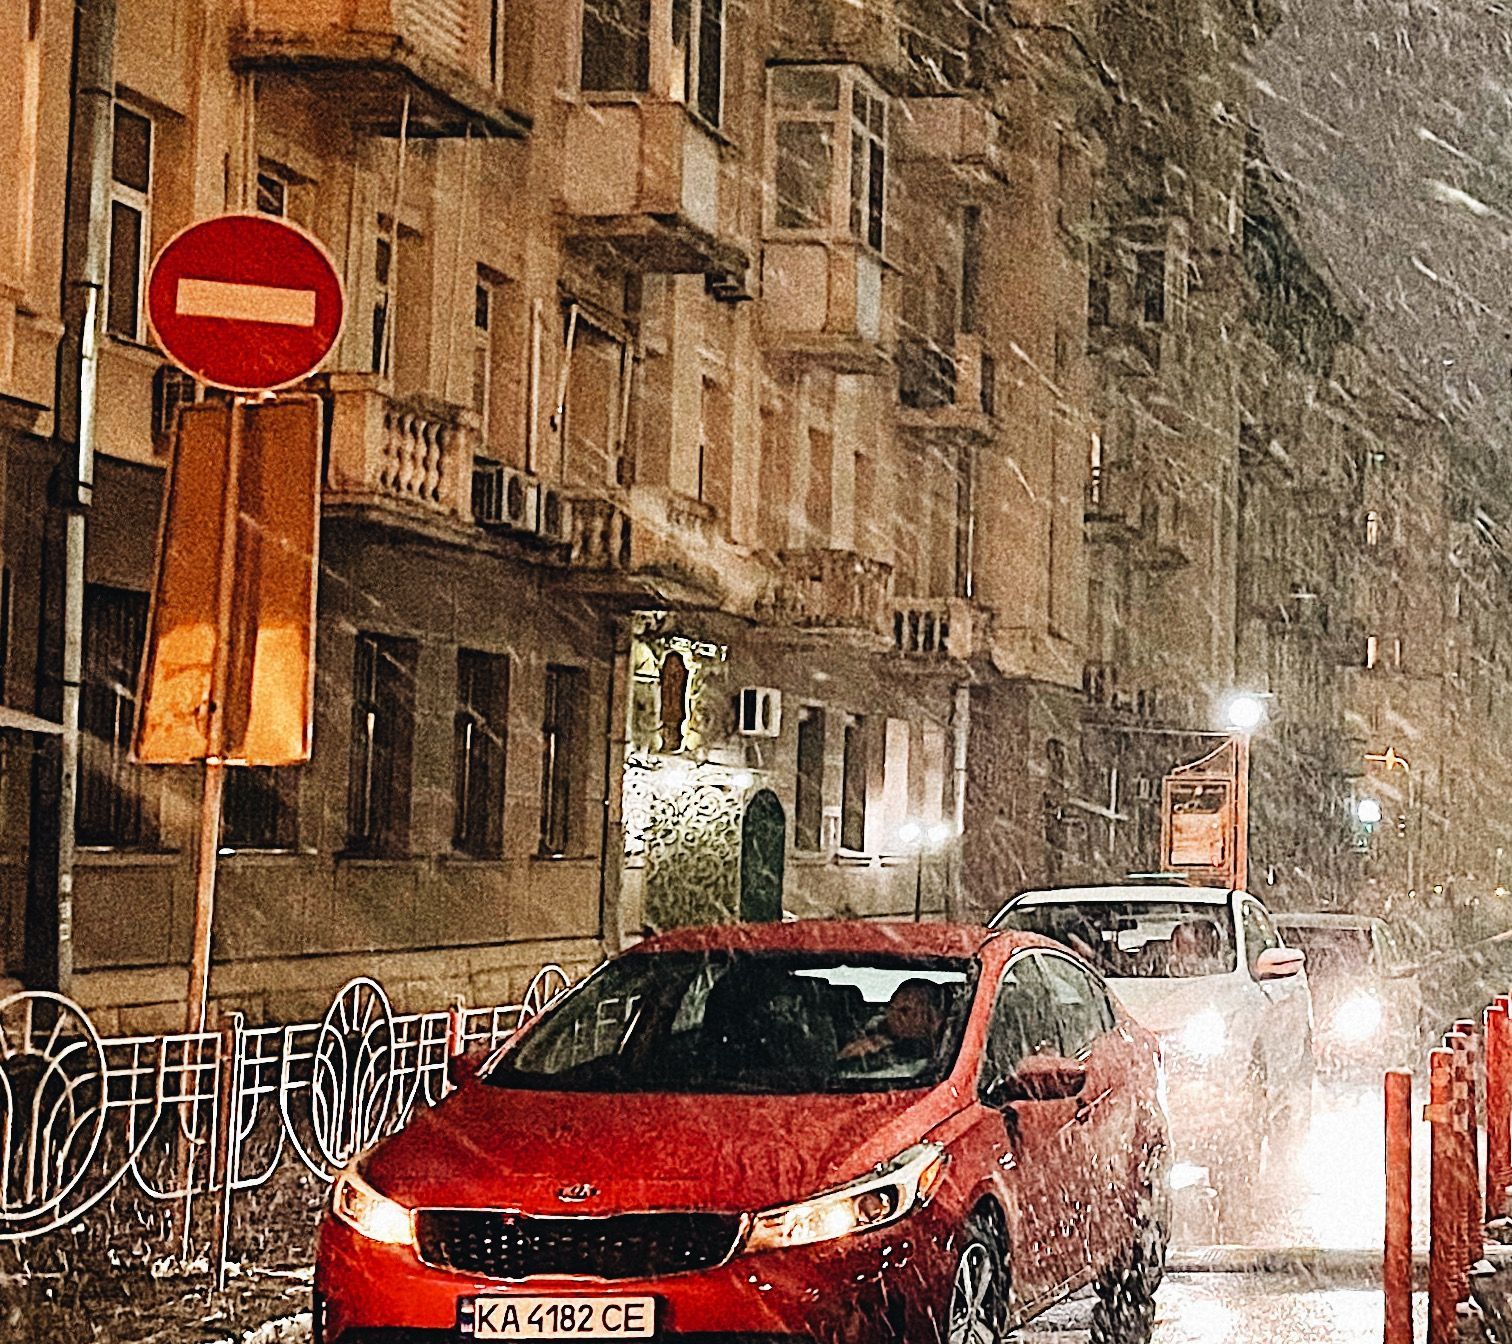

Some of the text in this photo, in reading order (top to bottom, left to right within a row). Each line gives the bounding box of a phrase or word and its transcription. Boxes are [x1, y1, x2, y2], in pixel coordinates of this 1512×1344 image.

[478, 1303, 645, 1332] KA 4182 CE
